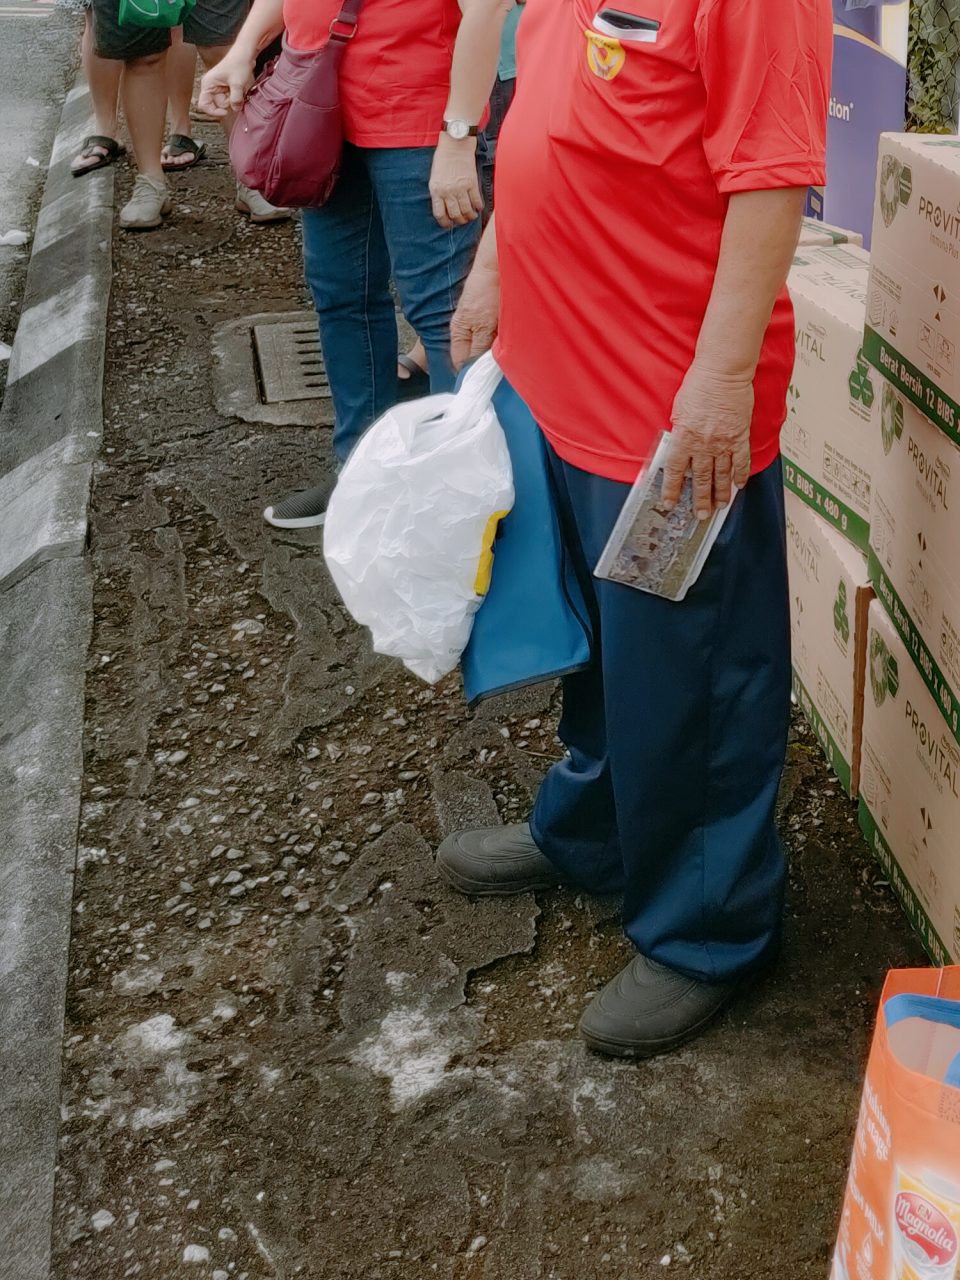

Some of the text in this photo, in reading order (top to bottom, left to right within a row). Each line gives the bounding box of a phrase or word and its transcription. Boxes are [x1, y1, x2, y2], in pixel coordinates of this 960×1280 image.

[879, 345, 900, 377] Berat
[899, 363, 923, 399] Bersih
[925, 386, 935, 410] 12
[936, 397, 955, 428] BIBS
[785, 464, 795, 484] 12
[796, 472, 815, 500] BIBS
[816, 491, 822, 508] x
[823, 496, 840, 520] 480
[907, 435, 949, 511] PROVITAL
[911, 631, 920, 656] 12
[905, 699, 959, 799] PROVITAL
[916, 908, 926, 937] 12
[895, 1197, 954, 1254] Magnolia
